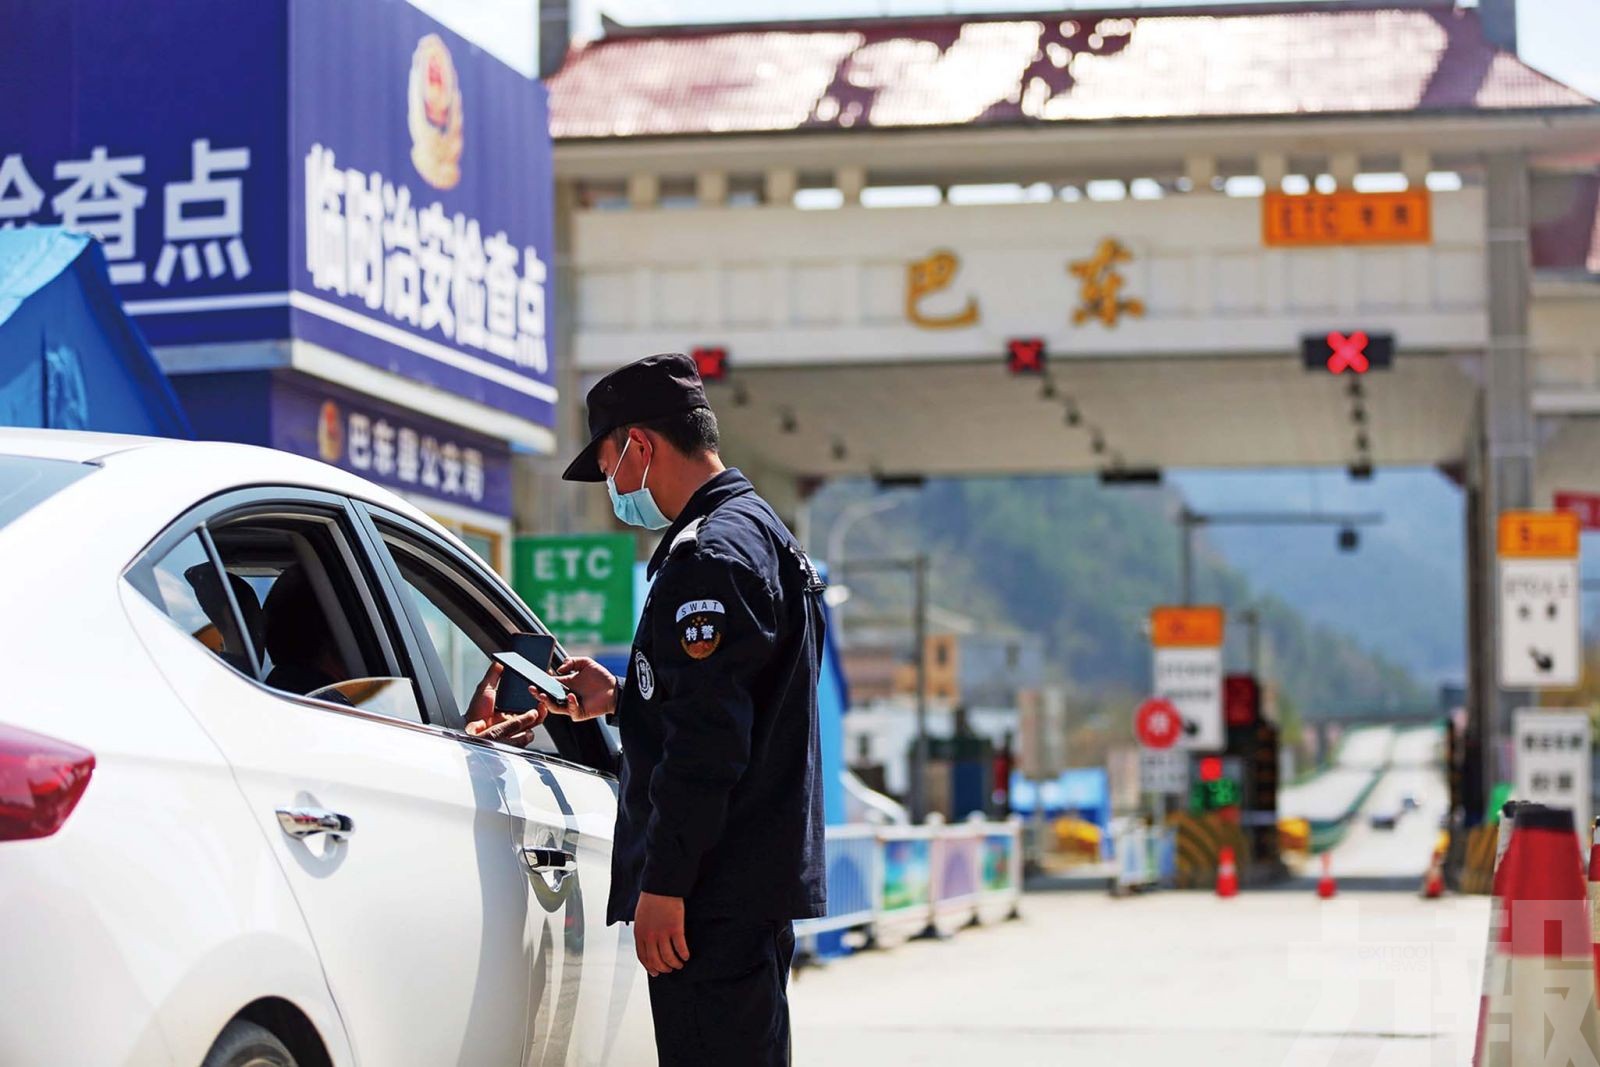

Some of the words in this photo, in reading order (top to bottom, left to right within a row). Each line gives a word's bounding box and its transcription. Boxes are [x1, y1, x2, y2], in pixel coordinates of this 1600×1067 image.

[304, 142, 547, 375] 临时治安检查点
[533, 547, 612, 580] ETC
[681, 601, 718, 616] SWAT
[685, 624, 714, 641] 特警
